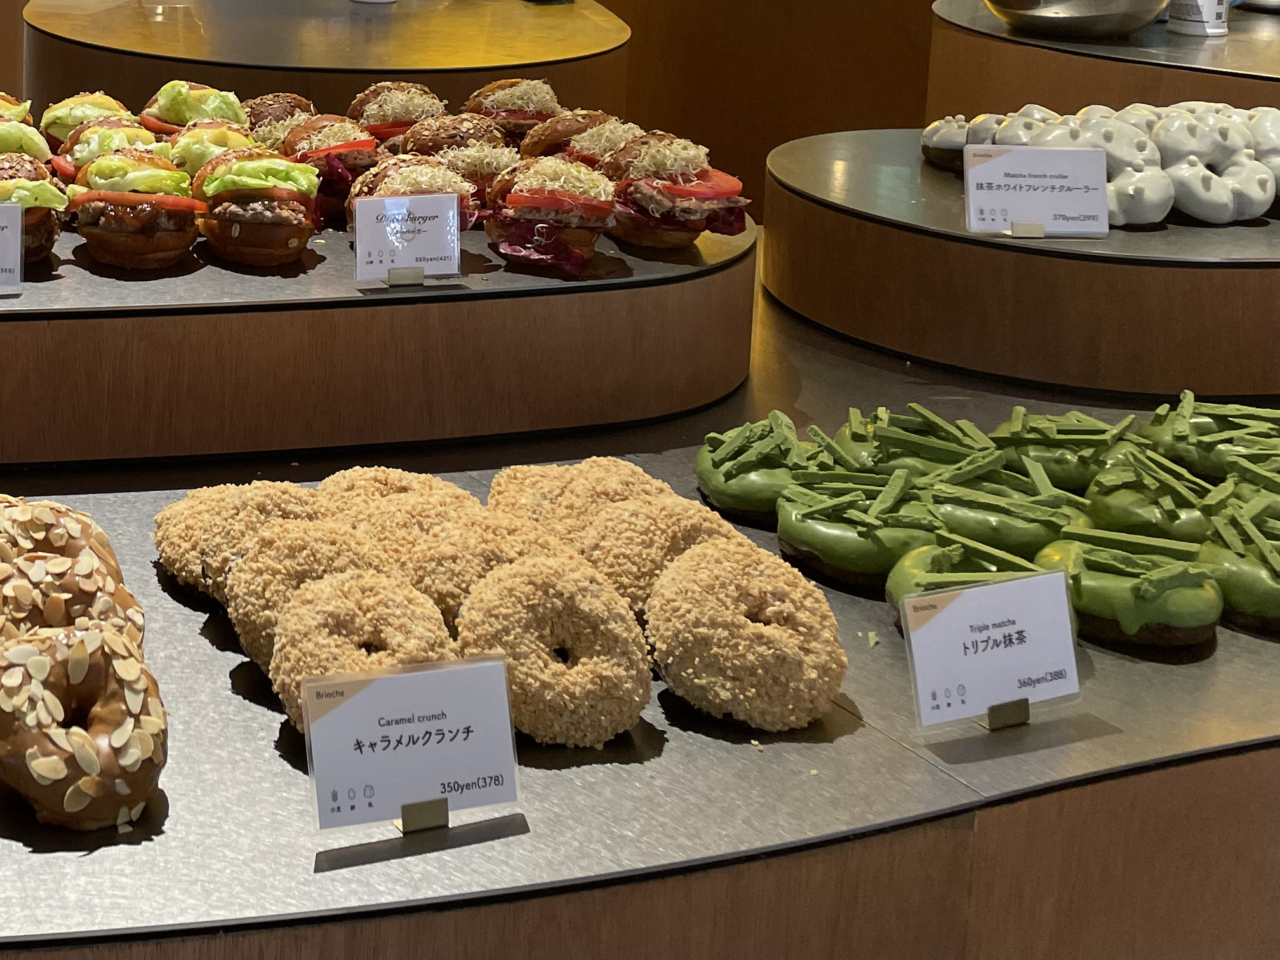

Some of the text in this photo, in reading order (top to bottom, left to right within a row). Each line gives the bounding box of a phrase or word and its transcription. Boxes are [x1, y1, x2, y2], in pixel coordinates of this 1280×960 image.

[969, 618, 1016, 634] Triple matcha
[963, 629, 1027, 656] トリプル抹茶
[378, 711, 447, 727] Caramel crunch
[354, 725, 474, 754] キャラメルクランチ
[440, 774, 504, 794] 350yen(378)
